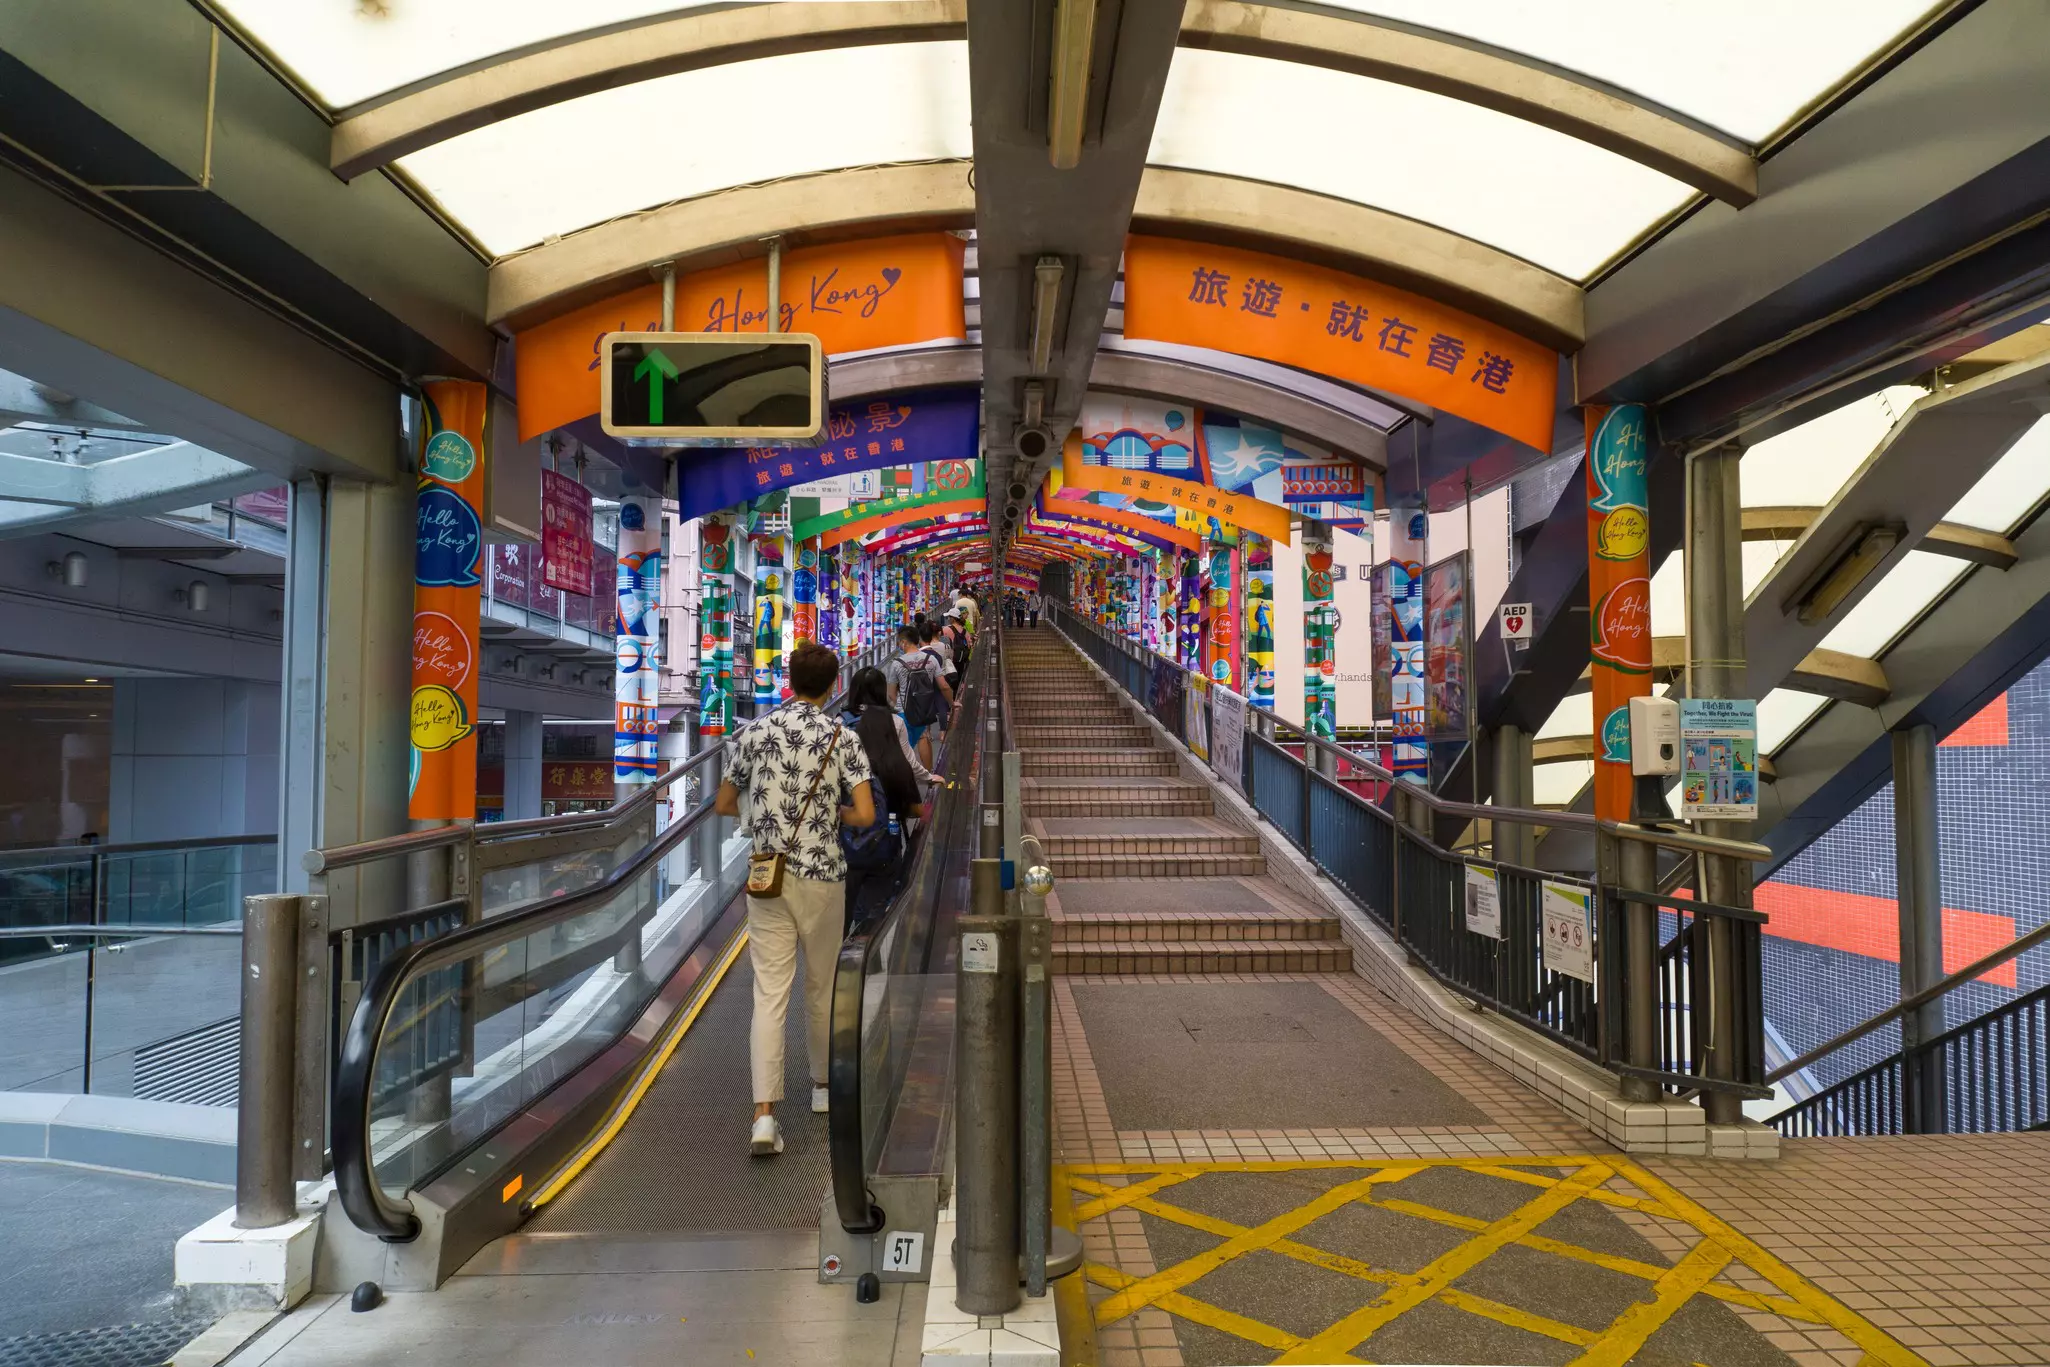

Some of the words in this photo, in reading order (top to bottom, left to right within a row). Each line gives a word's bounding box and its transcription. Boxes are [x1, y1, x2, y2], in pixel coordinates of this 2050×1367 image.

[811, 268, 893, 318] Kong
[1603, 450, 1646, 478] Hong
[417, 504, 459, 531] Hello
[1612, 517, 1640, 530] Hello
[437, 528, 469, 554] Kong
[1606, 530, 1627, 541] Hong
[1503, 606, 1527, 616] AED
[1607, 616, 1644, 638] Hong
[414, 628, 454, 651] Hello
[430, 653, 461, 677] Kong
[414, 700, 445, 717] Hello
[432, 712, 452, 724] Kong
[893, 1238, 914, 1265] 5T
